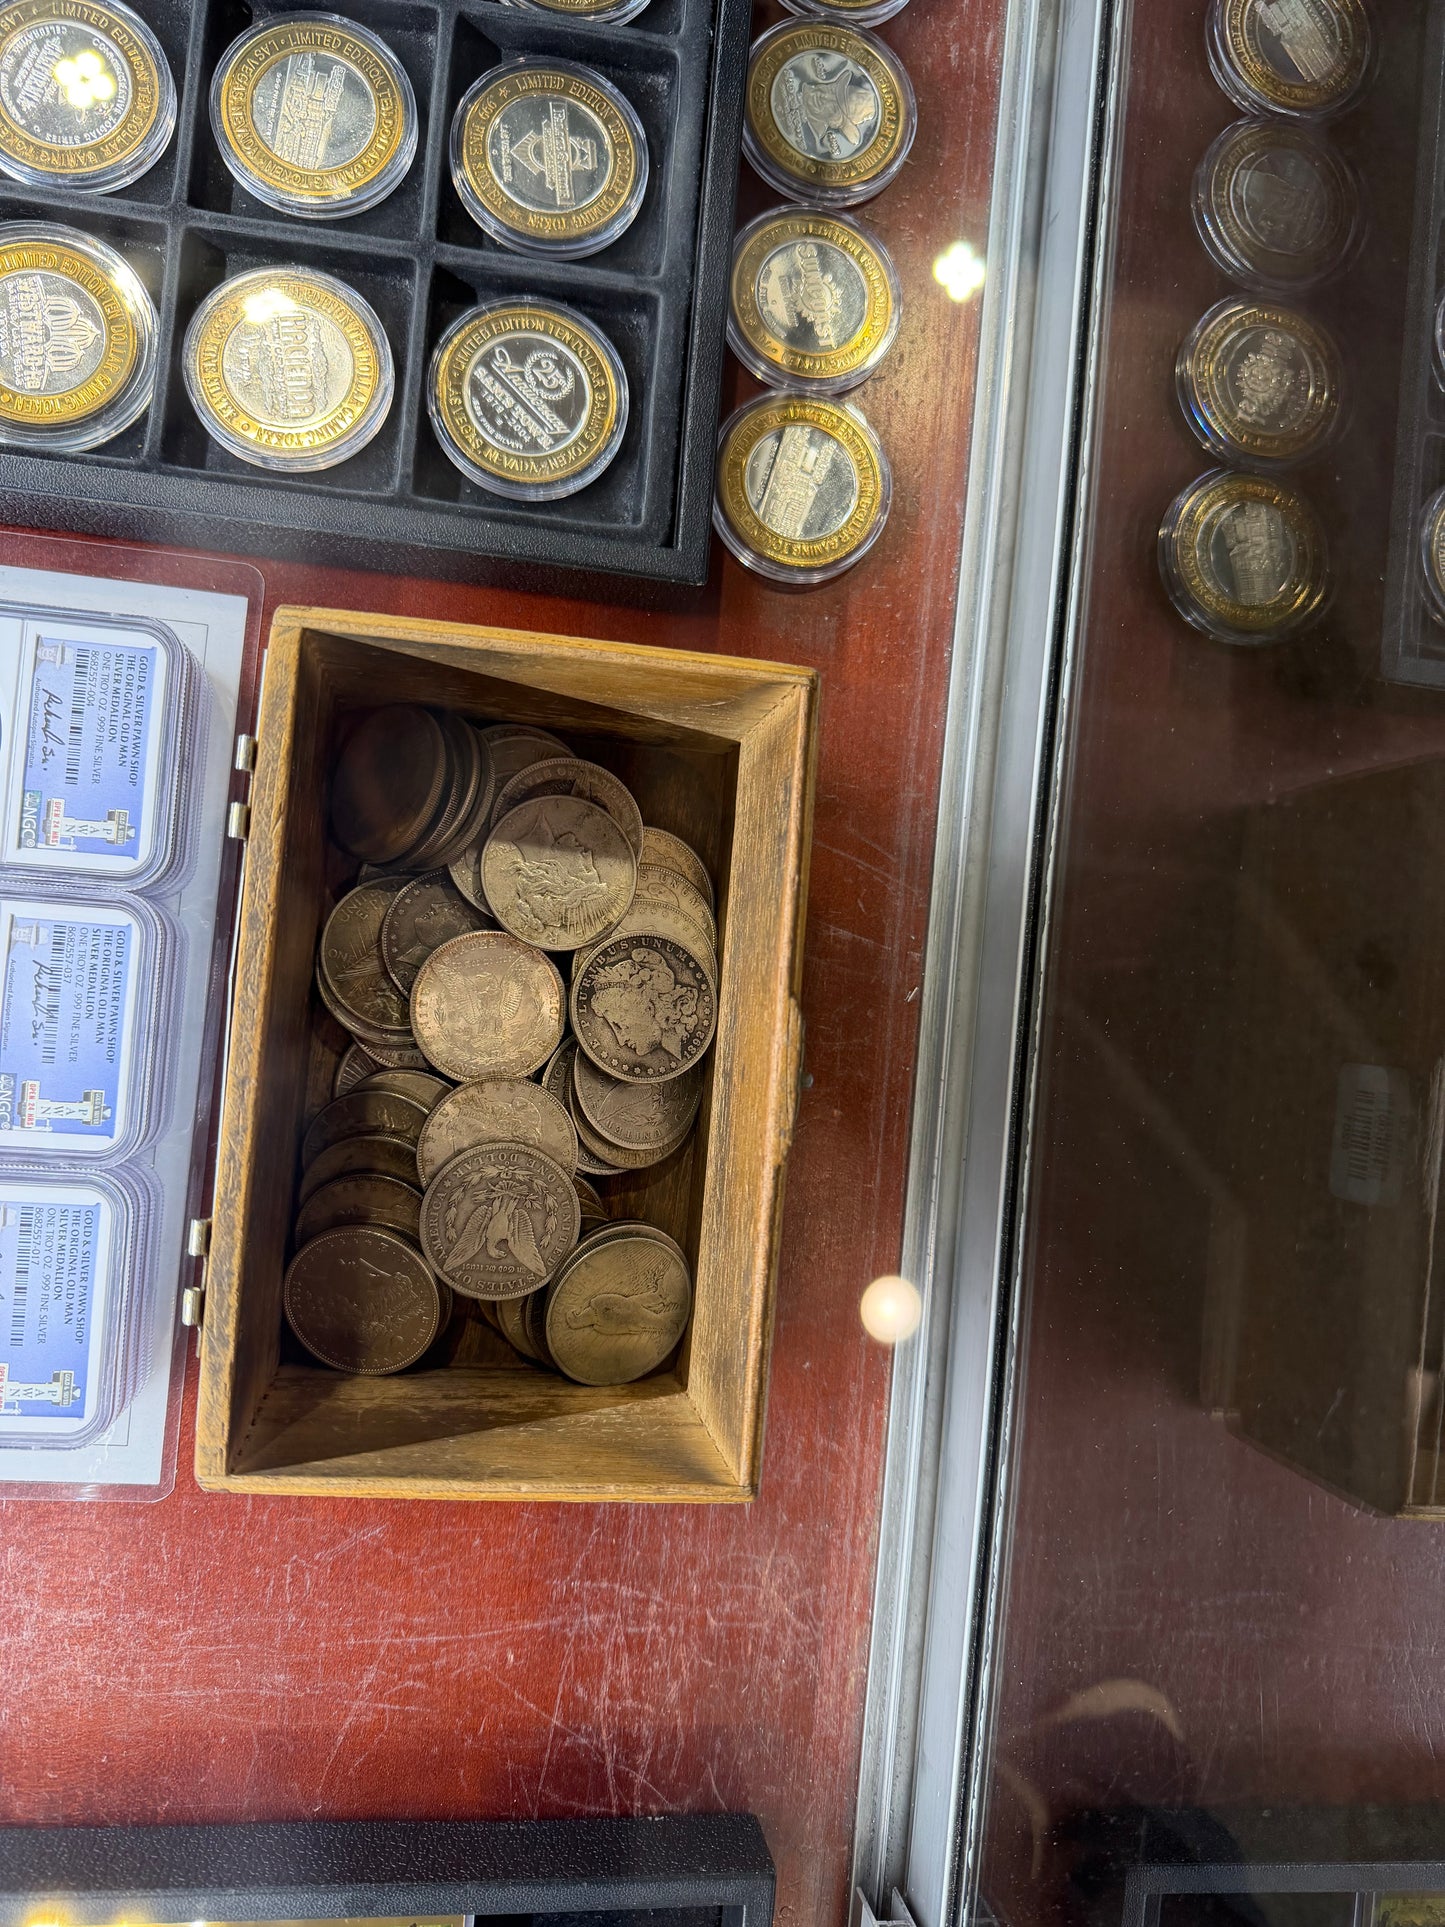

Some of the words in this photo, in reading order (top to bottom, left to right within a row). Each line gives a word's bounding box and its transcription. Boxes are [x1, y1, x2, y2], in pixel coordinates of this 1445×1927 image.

[53, 3, 109, 29] LIMITED
[111, 27, 149, 80] EDITION
[259, 40, 279, 57] LAS
[288, 32, 341, 49] LIMITED
[343, 43, 385, 89] EDITION
[515, 75, 564, 91] LIMITED
[136, 84, 151, 110] TEN
[378, 89, 396, 115] TEN
[569, 81, 613, 119] EDITION
[794, 32, 837, 49] LIMITED
[855, 137, 889, 172] GAMING
[104, 114, 147, 157] DOLLAR
[233, 103, 258, 160] NEVADA
[367, 117, 396, 167] DOLLAR
[609, 119, 628, 143] TEN
[264, 162, 310, 188] TOKEN
[315, 163, 366, 191] GAMING
[526, 213, 568, 231] TOKEN
[572, 195, 615, 228] GAMING
[1, 252, 57, 272] LIMITED
[60, 258, 109, 298] EDITION
[102, 295, 120, 320] TEN
[795, 243, 838, 350] SUNCOAST
[492, 317, 545, 335] EDITION
[549, 321, 573, 344] TEN
[104, 323, 128, 375] DOLLAR
[454, 328, 490, 372] LIMITED
[572, 341, 605, 388] DOLLAR
[14, 394, 64, 415] TOKEN
[68, 375, 113, 410] GAMING
[255, 427, 304, 448] TOKEN
[304, 408, 355, 445] GAMING
[549, 441, 589, 471] TOKEN
[837, 423, 870, 471] EDITION
[792, 541, 839, 557] GAMING
[102, 652, 111, 671] ONE
[114, 653, 124, 684] SILVER
[126, 655, 135, 671] THE
[137, 656, 148, 682] GOLD
[87, 650, 99, 706] 8682557-004
[100, 674, 109, 695] TROY
[33, 678, 42, 711] Authorized
[99, 698, 107, 711] OZ
[122, 673, 134, 720] ORIGINAL
[97, 713, 106, 732] .999
[108, 686, 121, 742] MEDALLION
[134, 695, 145, 727] SILVER
[30, 712, 39, 738] Autopen
[120, 723, 130, 743] OLD
[29, 740, 37, 768] Signature
[95, 735, 104, 753] FINE
[118, 745, 128, 767] MAN
[131, 729, 142, 758] PAWN
[92, 756, 102, 784] SILVER
[129, 760, 139, 786] SHOP
[53, 801, 61, 817] OPEN
[51, 831, 59, 843] HRS
[52, 821, 60, 829] 24
[65, 824, 112, 835] PAWN
[79, 927, 88, 947] ONE
[90, 928, 101, 960] SILVER
[104, 930, 113, 946] THE
[115, 931, 125, 958] GOLD
[641, 938, 687, 961] UNUM
[63, 926, 76, 984] 8682557-037
[77, 949, 86, 971] TROY
[7, 959, 16, 994] Authorized
[75, 975, 84, 989] OZ
[99, 948, 112, 996] ORIGINAL
[579, 941, 629, 1029] PLURIBUS
[85, 963, 98, 1020] MEDALLION
[111, 970, 122, 1002] SILVER
[4, 995, 13, 1021] Autopen
[73, 990, 83, 1009] .999
[98, 999, 107, 1019] OLD
[71, 1012, 81, 1030] FINE
[95, 1021, 106, 1044] MAN
[108, 1005, 119, 1035] PAWN
[2, 1022, 11, 1050] Signature
[68, 1033, 79, 1062] SILVER
[591, 1039, 600, 1049] E
[683, 1031, 705, 1060] 1892
[106, 1037, 116, 1064] SHOP
[29, 1083, 37, 1100] OPEN
[26, 1113, 34, 1125] HRS
[28, 1103, 35, 1111] 24
[41, 1106, 89, 1116] PAWN
[453, 1153, 520, 1178] DOLLAR
[527, 1158, 556, 1183] ONE
[46, 1208, 56, 1228] ONE
[58, 1209, 69, 1240] SILVER
[71, 1210, 81, 1227] THE
[83, 1210, 93, 1237] GOLD
[429, 1191, 448, 1260] AMERICA
[32, 1207, 43, 1265] 8682557-017
[44, 1230, 54, 1253] TROY
[547, 1200, 569, 1266] UNITED
[43, 1256, 52, 1269] OZ
[67, 1229, 80, 1277] ORIGINAL
[80, 1250, 90, 1282] SILVER
[41, 1272, 51, 1291] .999
[53, 1243, 66, 1301] MEDALLION
[452, 1270, 472, 1285] OF
[477, 1273, 536, 1292] STATES
[66, 1279, 76, 1299] OLD
[77, 1285, 88, 1316] PAWN
[40, 1294, 50, 1312] FINE
[64, 1302, 74, 1325] MAN
[37, 1315, 48, 1344] SILVER
[75, 1318, 85, 1344] SHOP
[10, 1388, 57, 1398] PAWN
